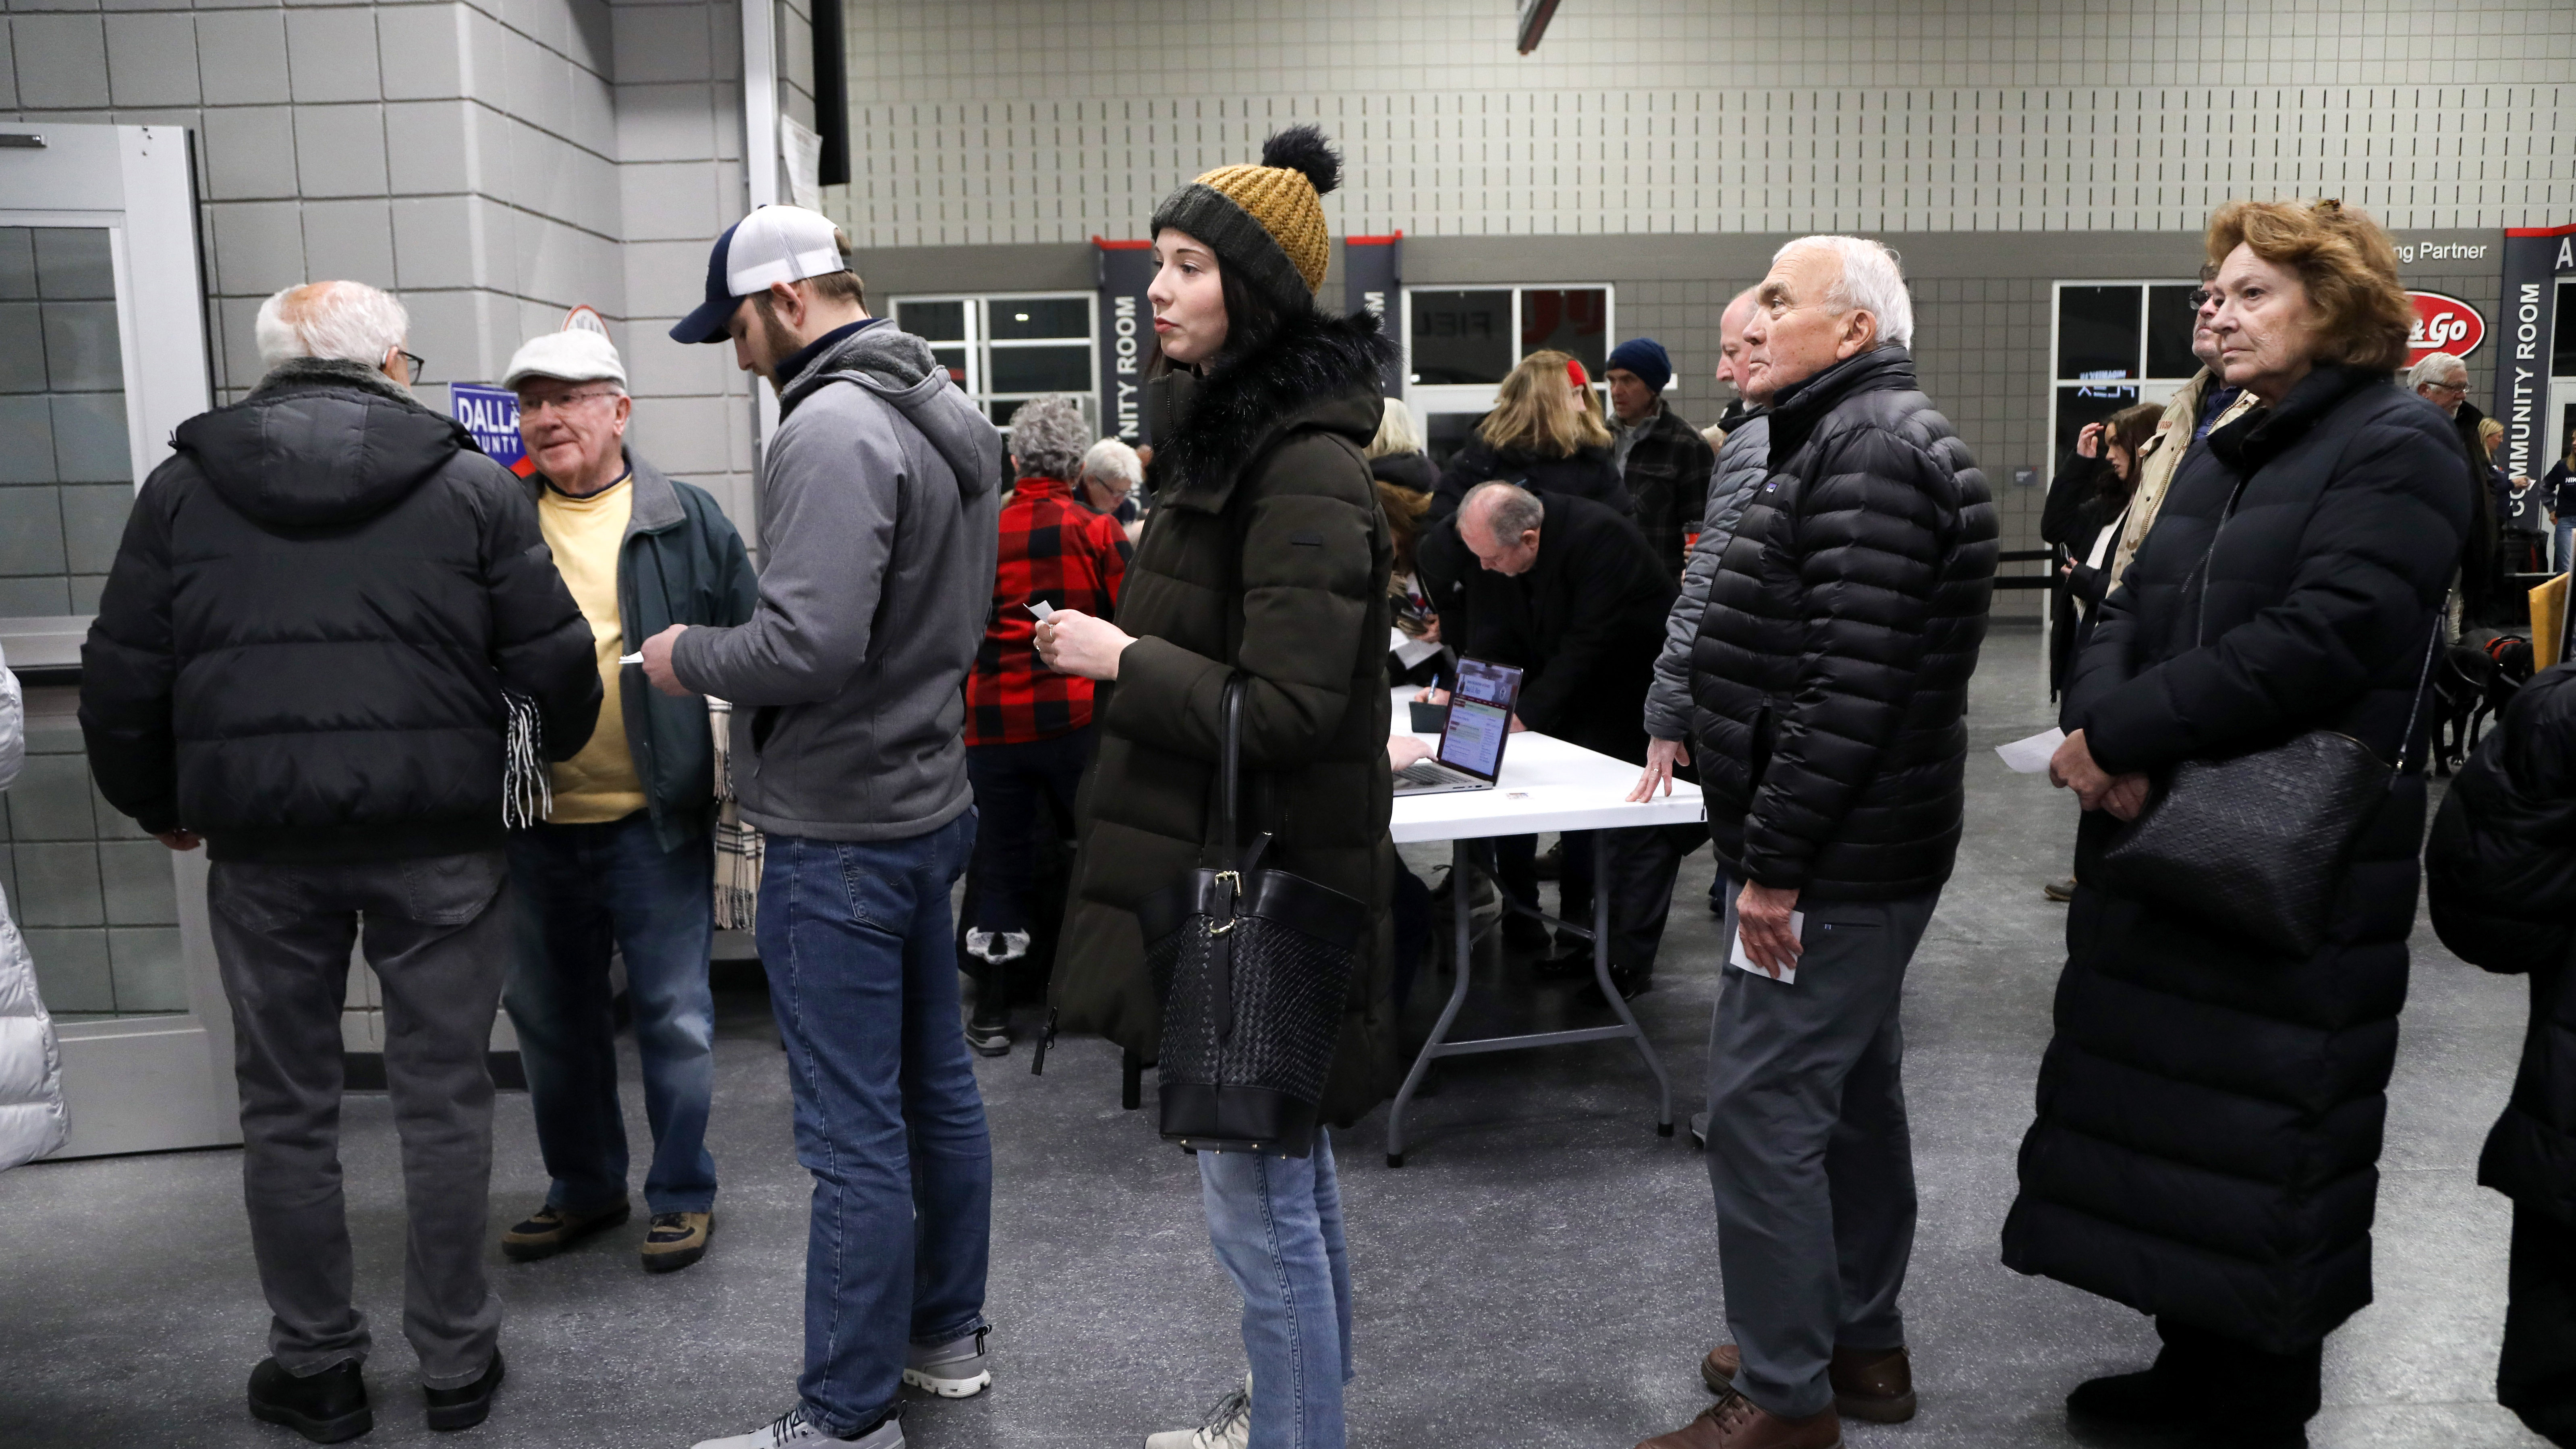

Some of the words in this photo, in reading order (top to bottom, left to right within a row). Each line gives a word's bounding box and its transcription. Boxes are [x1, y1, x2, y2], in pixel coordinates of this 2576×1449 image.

[2419, 242, 2487, 259] Partner
[1115, 296, 1138, 374] ROOM
[2516, 283, 2540, 360] ROOM
